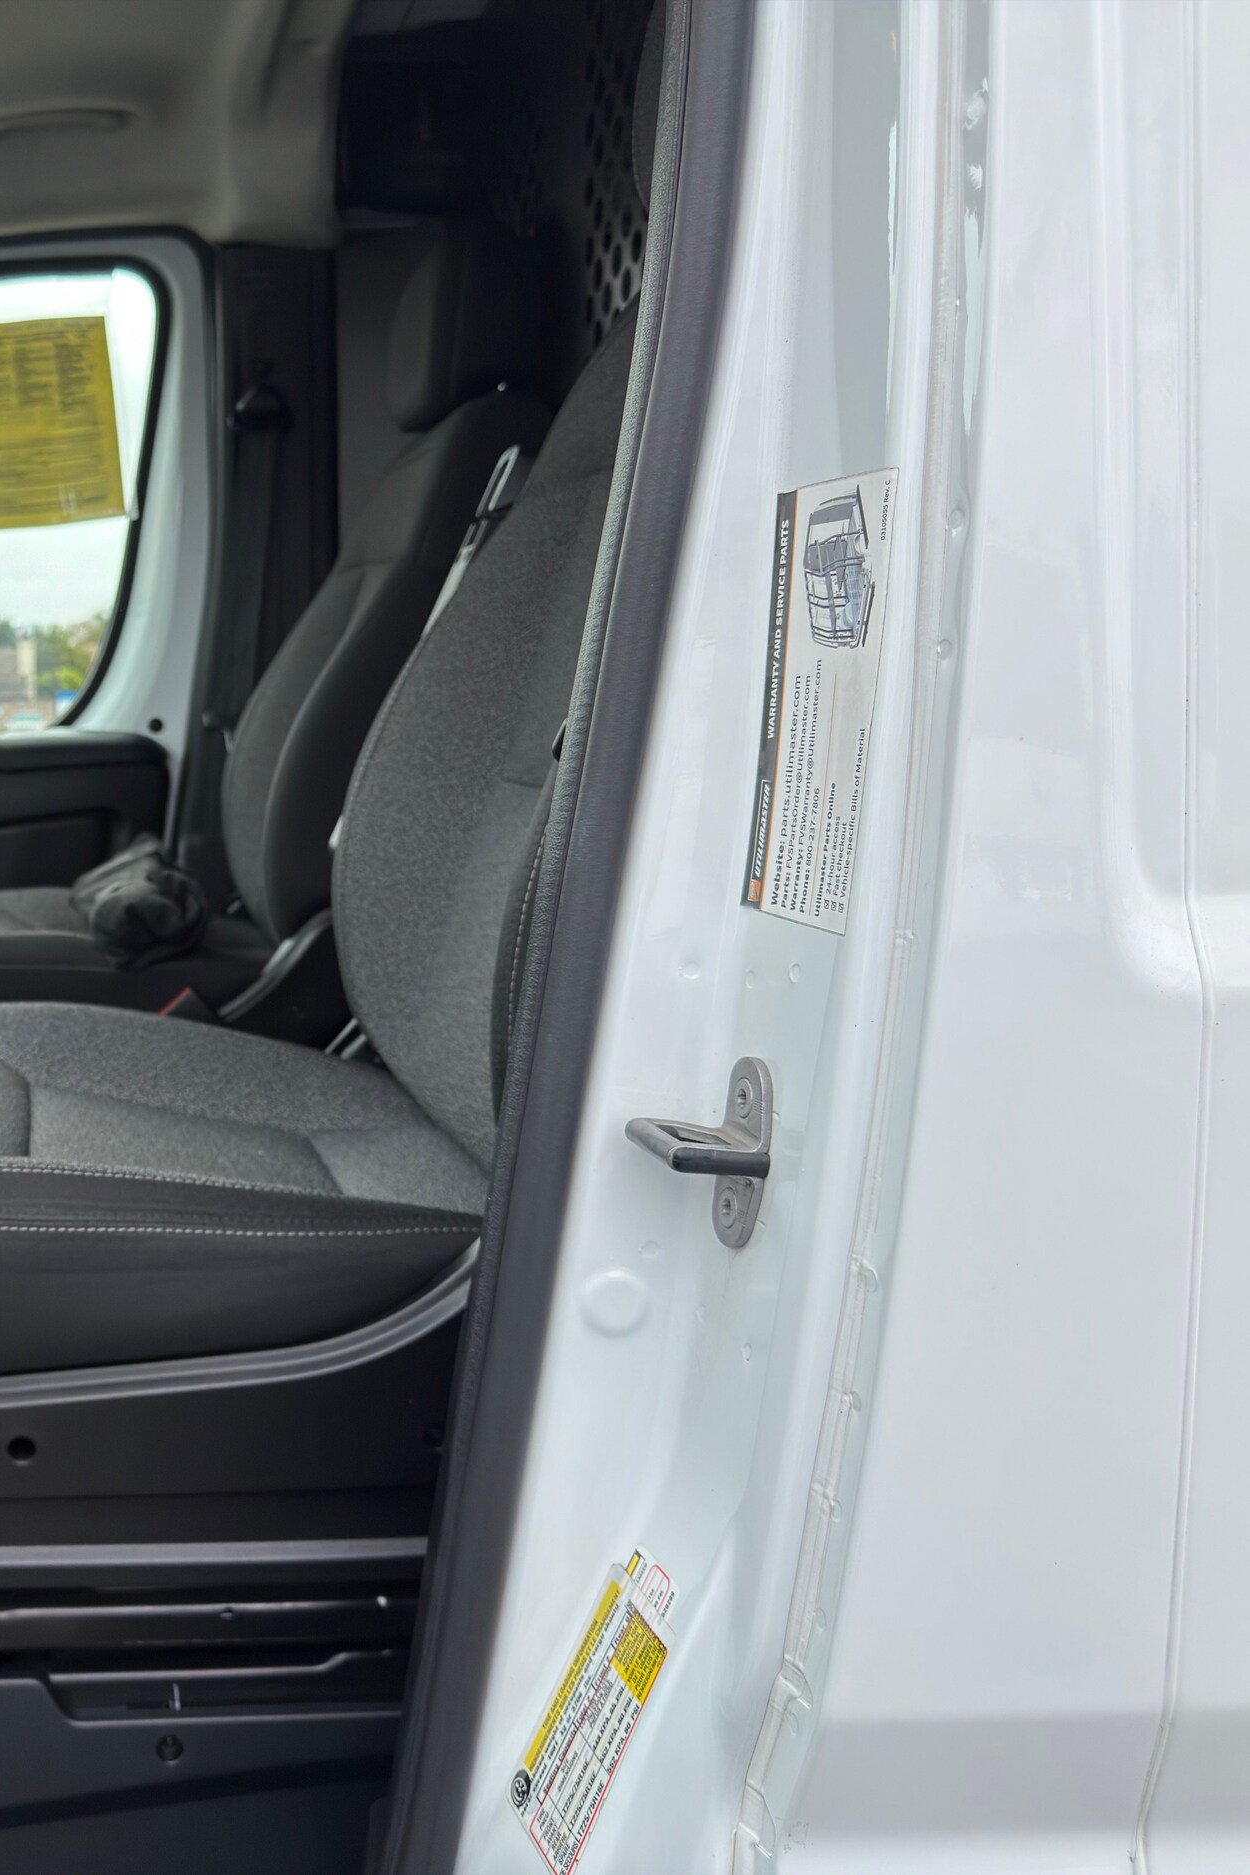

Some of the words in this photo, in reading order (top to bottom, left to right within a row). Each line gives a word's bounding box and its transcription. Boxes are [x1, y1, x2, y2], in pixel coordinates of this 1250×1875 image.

[778, 520, 790, 564] PARTS
[774, 567, 787, 625] SERVICE
[773, 629, 782, 658] AND
[767, 661, 780, 739] WARRANTY
[791, 849, 804, 911] Warranty:
[798, 660, 824, 845] FVSWarranty@Utilimaster.com
[854, 776, 860, 786] of
[855, 728, 865, 772] Material
[771, 840, 785, 906] Website:
[780, 676, 803, 837] parts.utilimaster.com
[782, 872, 790, 908] Parts:
[786, 676, 813, 869] FVSPartsOrder@Utilimaster.com
[800, 869, 810, 913] Phone:
[806, 787, 820, 866] 800-237-7806
[815, 854, 827, 917] Utilimaster
[823, 822, 831, 852] Parts
[828, 783, 836, 819] Online
[826, 853, 836, 895] 24-hour
[832, 816, 840, 851] access
[837, 822, 847, 871] checkout
[840, 814, 856, 899] Vehicle-specific
